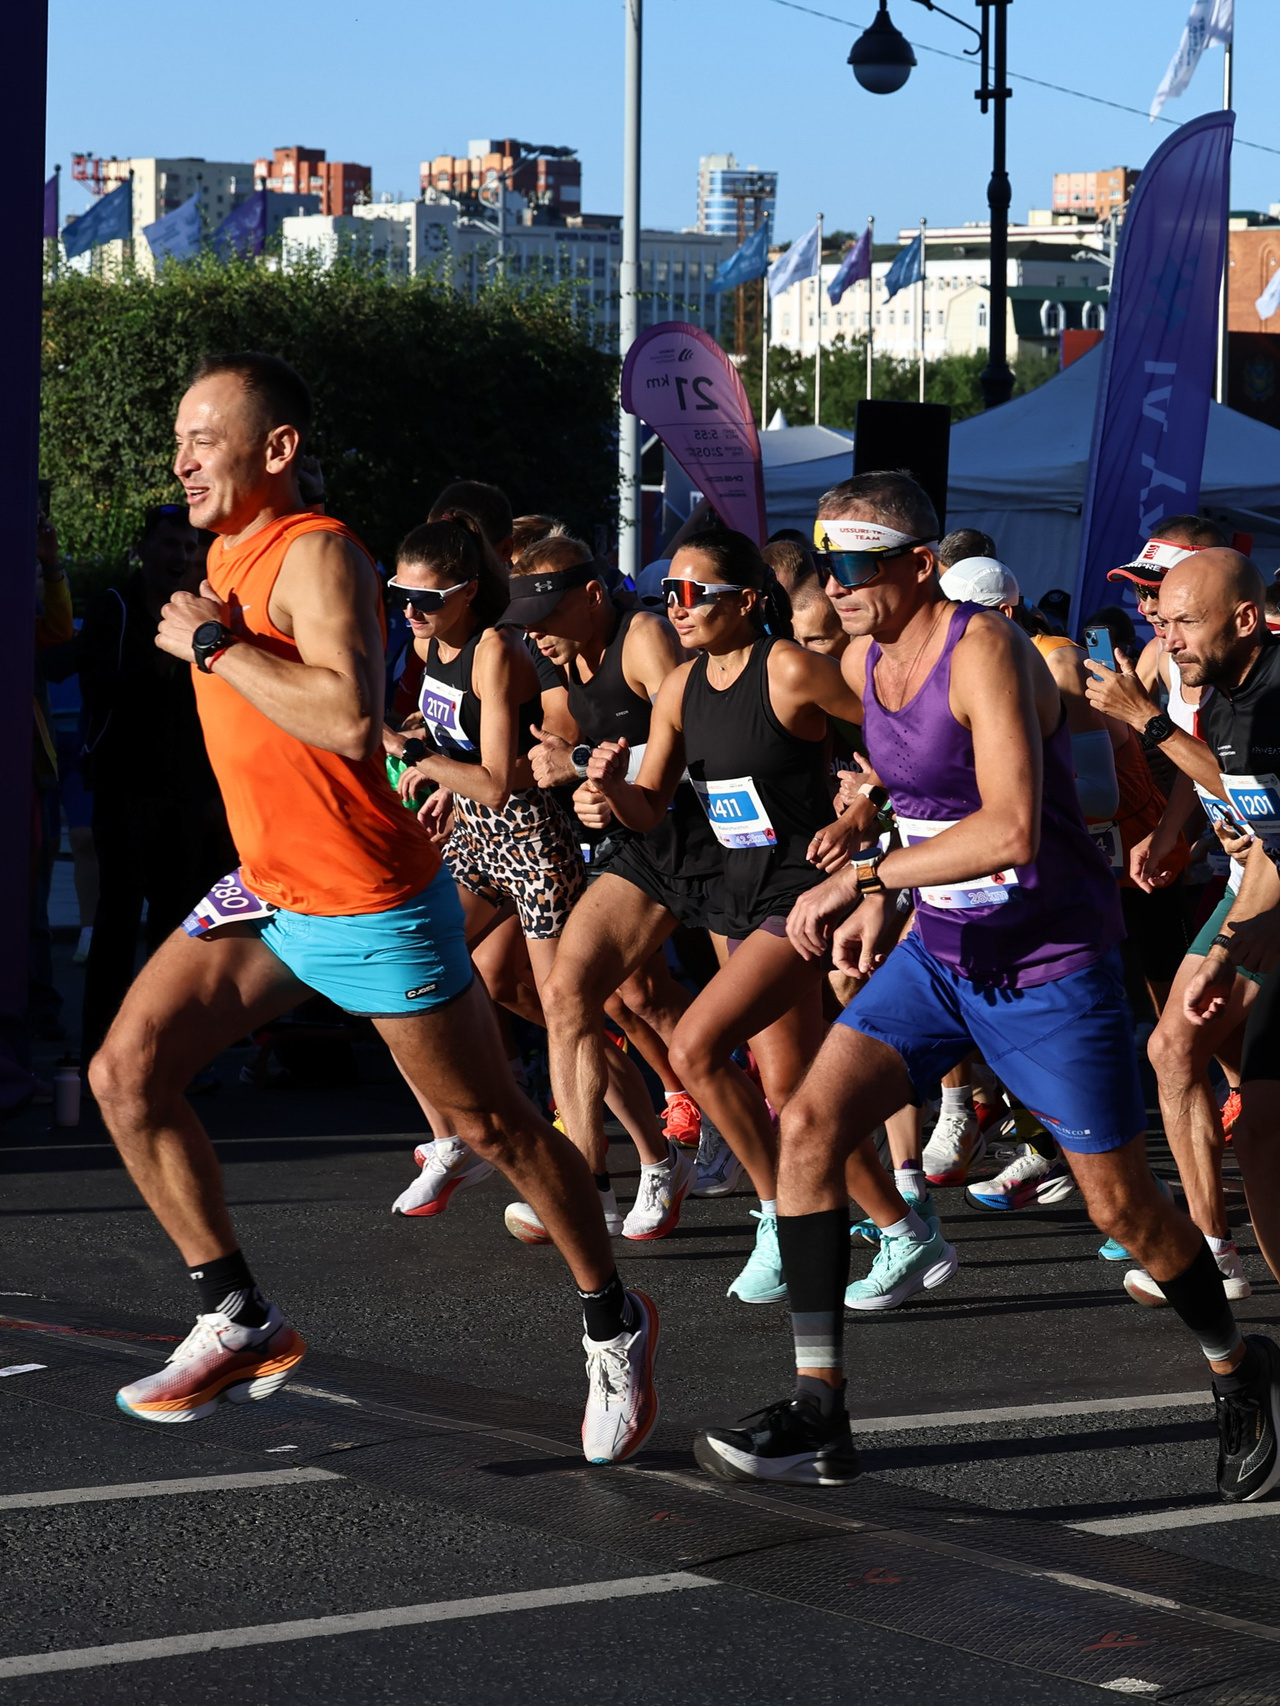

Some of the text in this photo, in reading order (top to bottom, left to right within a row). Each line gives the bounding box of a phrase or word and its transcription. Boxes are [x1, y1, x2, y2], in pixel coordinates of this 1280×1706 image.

[427, 697, 450, 722] 2177
[1238, 795, 1276, 815] 1201
[994, 872, 1003, 880] A
